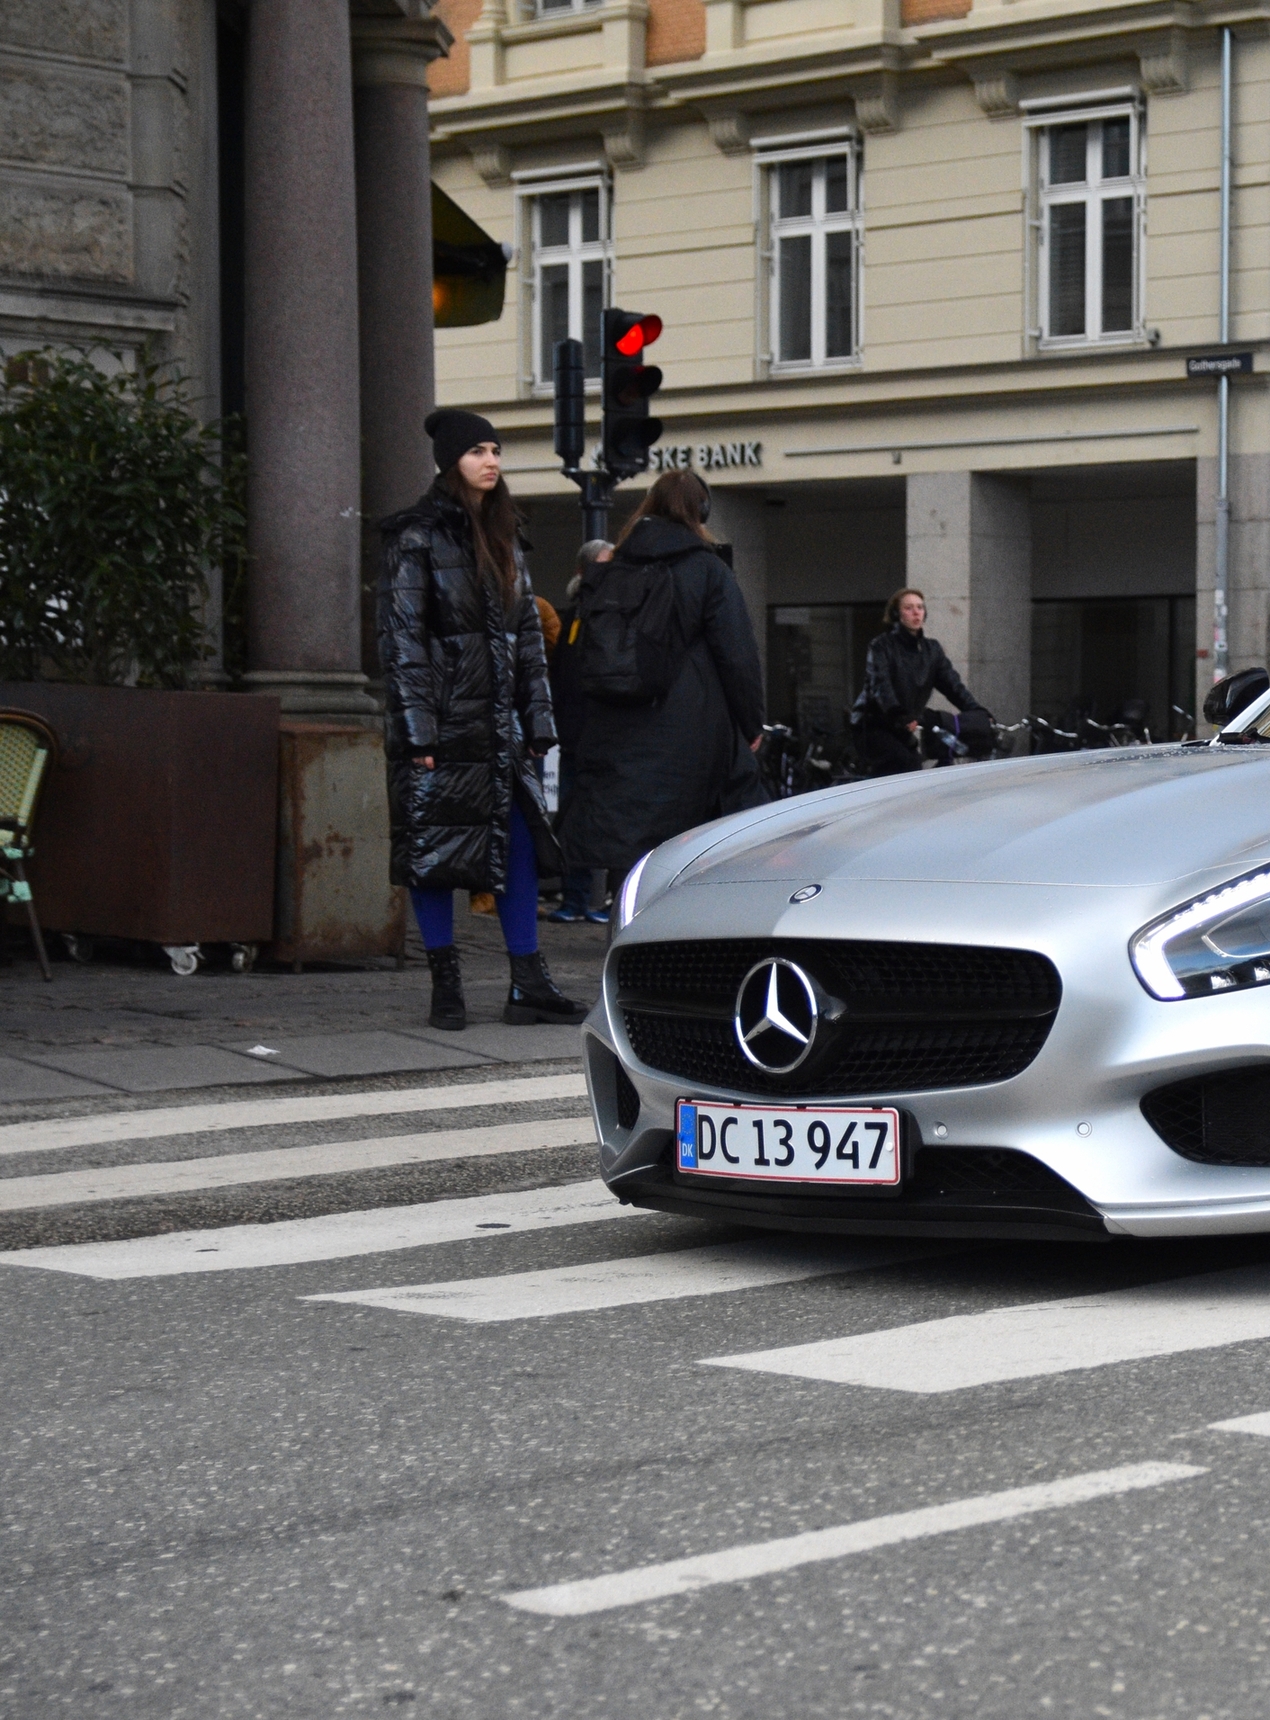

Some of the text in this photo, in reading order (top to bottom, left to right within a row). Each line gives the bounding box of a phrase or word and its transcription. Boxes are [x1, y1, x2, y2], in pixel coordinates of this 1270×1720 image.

[648, 441, 761, 471] SKE BANK
[682, 1142, 694, 1158] DK
[698, 1113, 889, 1171] DC 13 947
